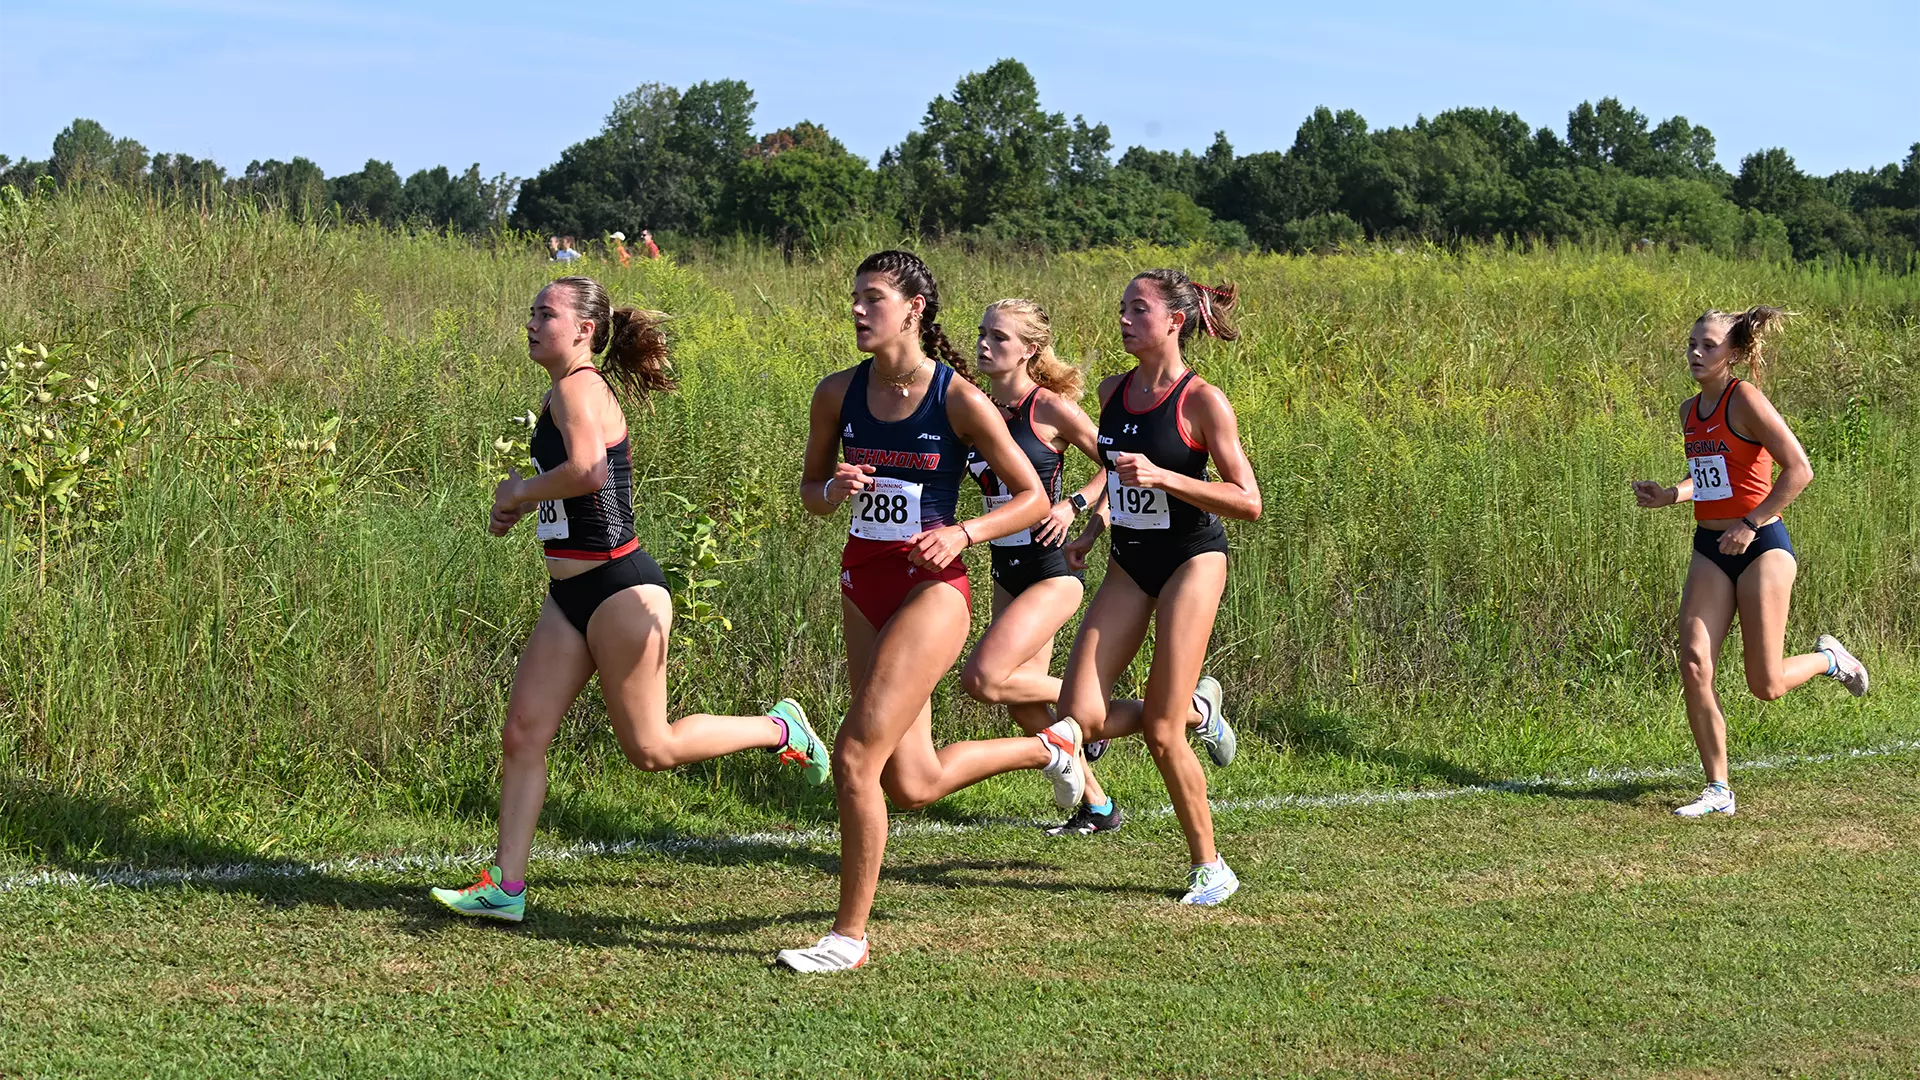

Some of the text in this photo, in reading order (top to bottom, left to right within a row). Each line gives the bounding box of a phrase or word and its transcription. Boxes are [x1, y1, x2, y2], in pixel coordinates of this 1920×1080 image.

[845, 446, 940, 470] RICHMOND
[1685, 439, 1731, 455] RGINIA
[1694, 467, 1721, 488] 313
[859, 493, 908, 524] 288
[1116, 486, 1157, 514] 192
